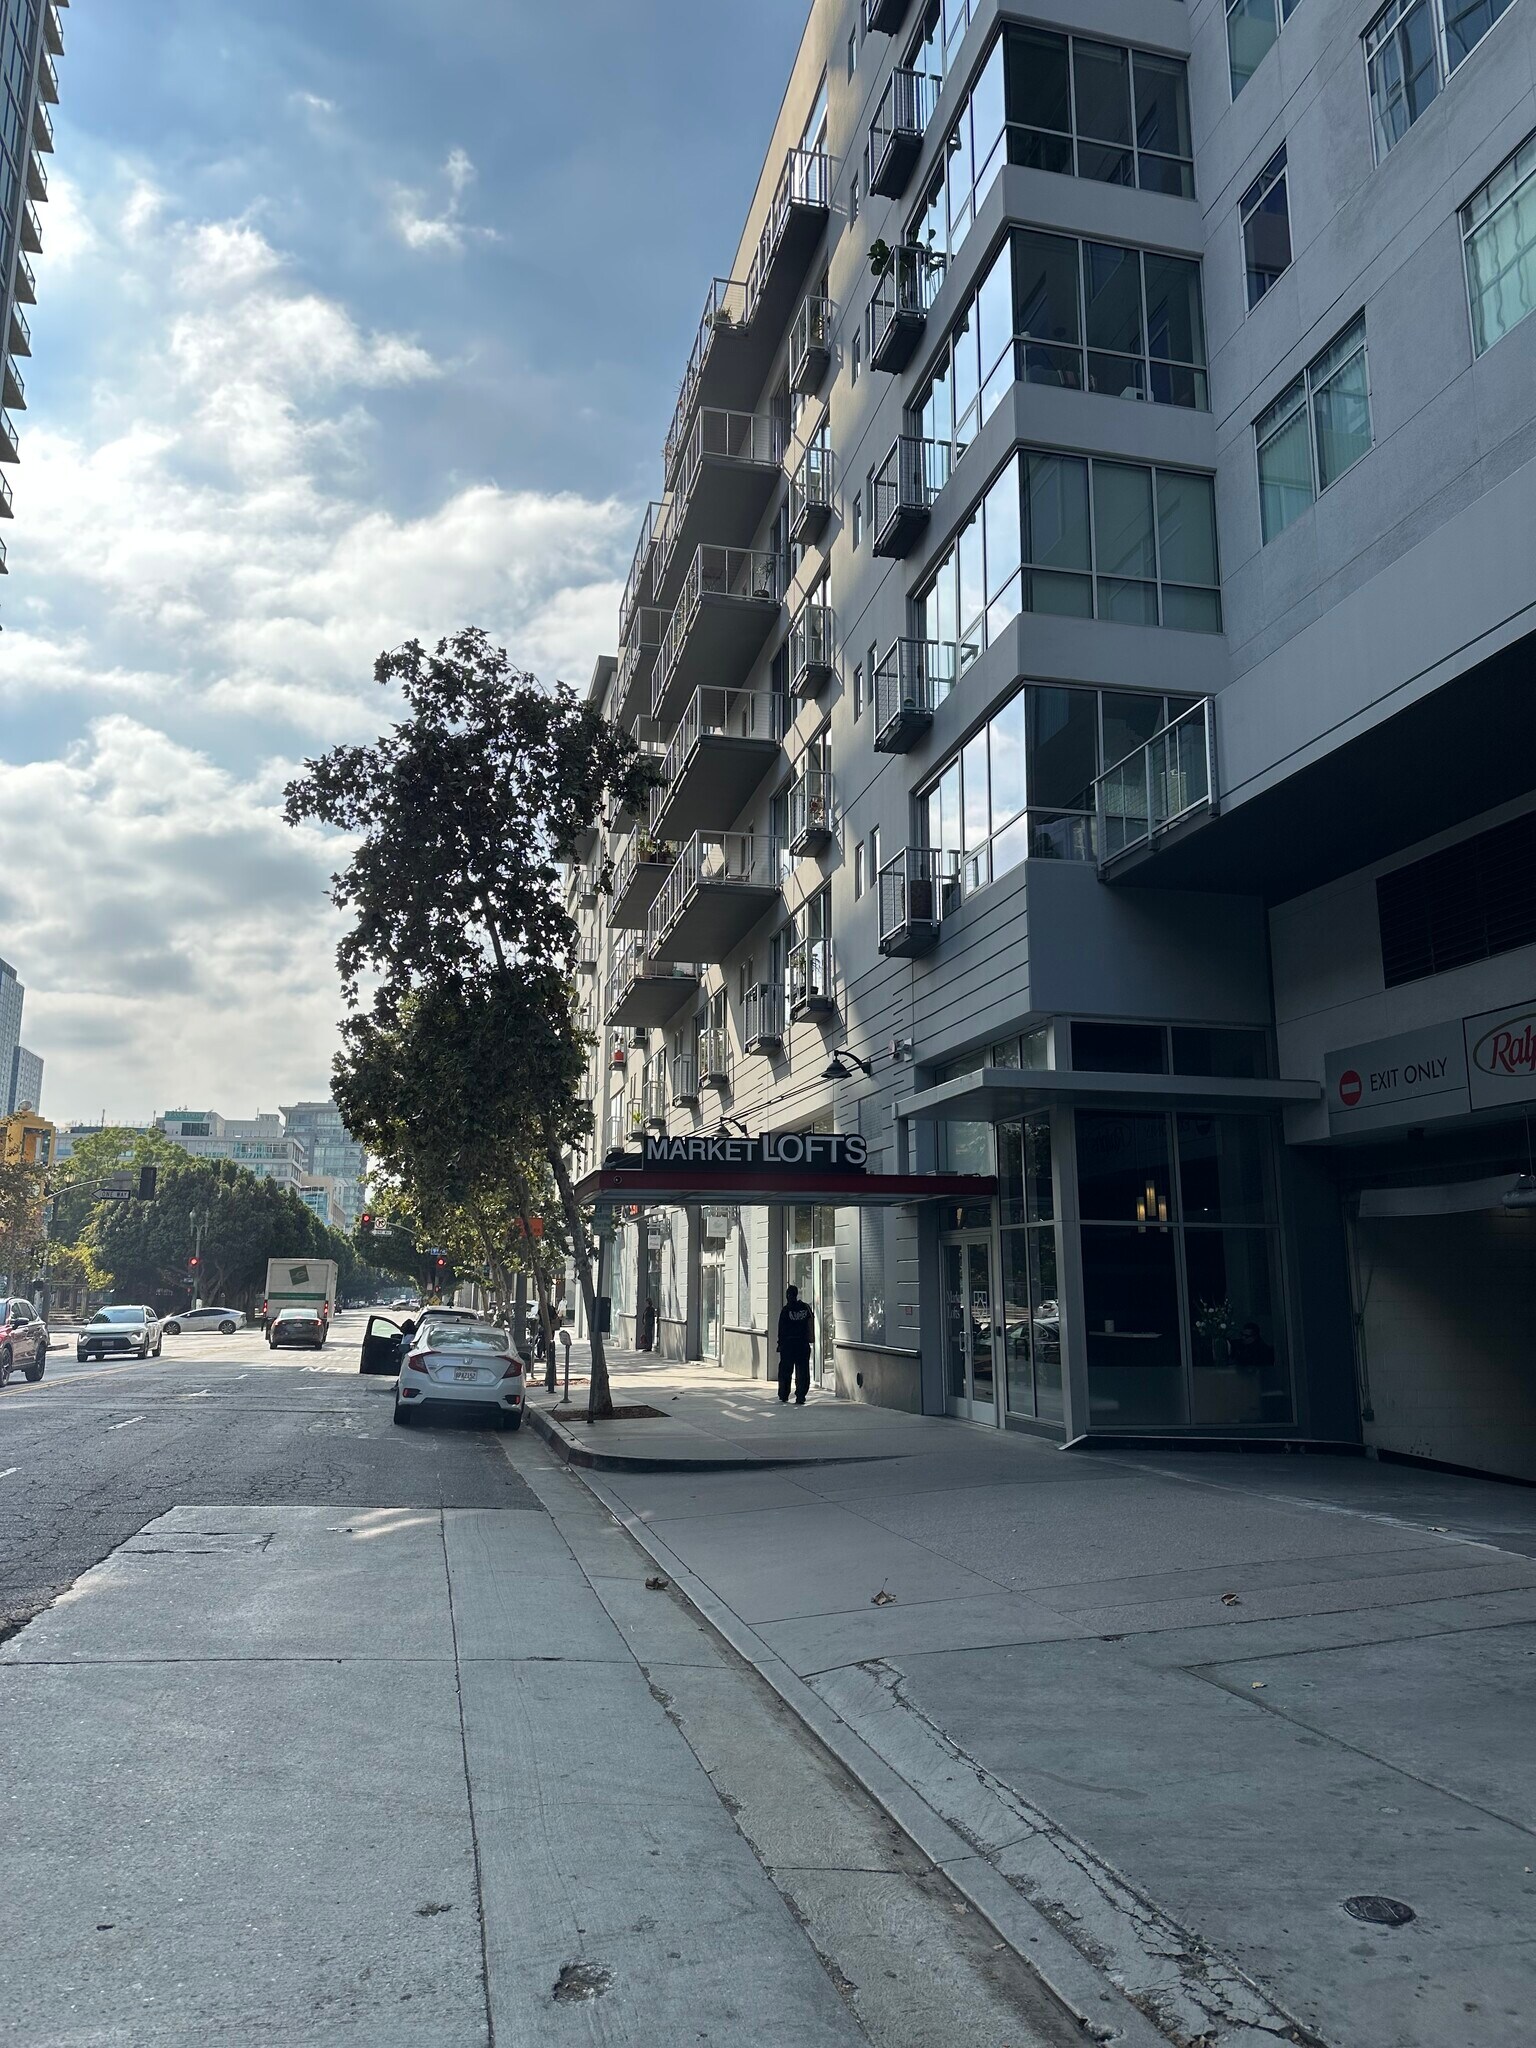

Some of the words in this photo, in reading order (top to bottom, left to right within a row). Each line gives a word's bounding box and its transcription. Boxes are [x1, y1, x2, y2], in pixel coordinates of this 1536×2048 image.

[1370, 1068, 1399, 1092] EXIT
[1404, 1057, 1448, 1084] ONLY
[647, 1138, 758, 1161] MARKET
[762, 1134, 867, 1164] LOFTS
